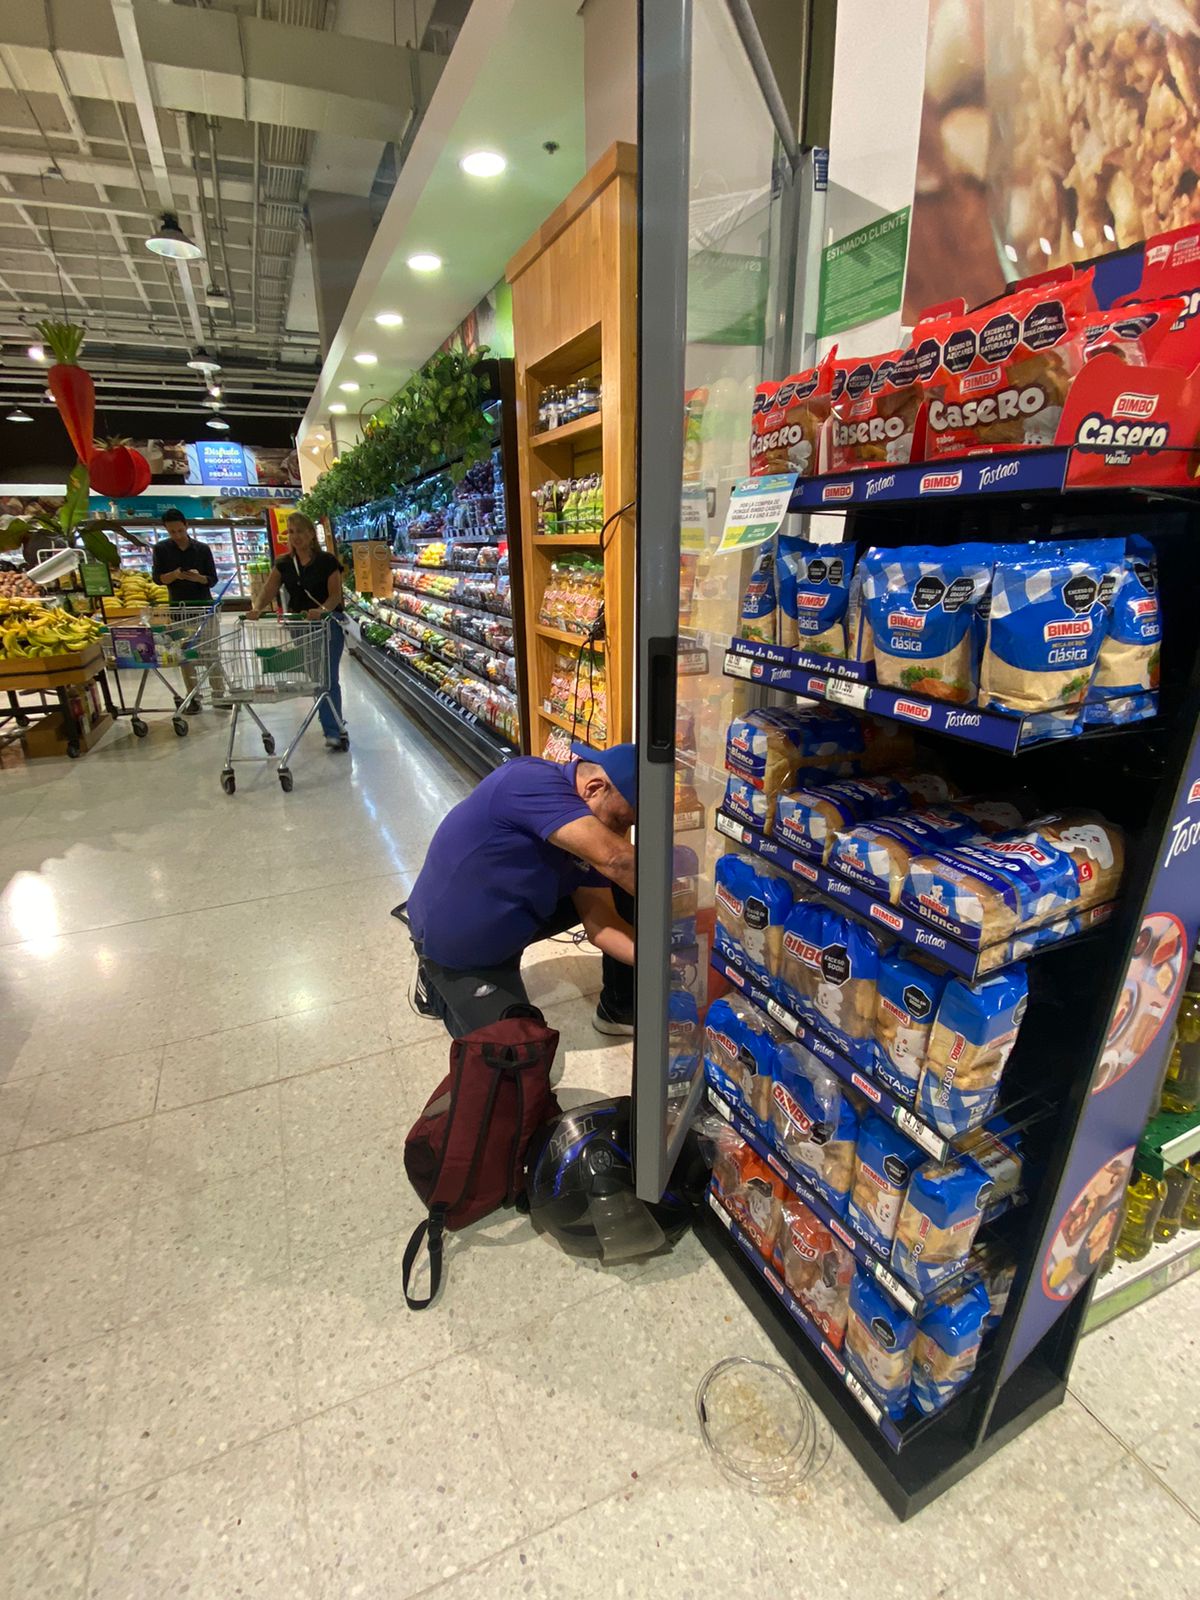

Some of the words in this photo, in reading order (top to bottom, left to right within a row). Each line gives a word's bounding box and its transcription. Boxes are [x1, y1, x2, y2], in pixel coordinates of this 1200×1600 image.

[827, 233, 866, 261] ESTIMADO
[869, 213, 907, 240] CLIENTE
[963, 372, 999, 389] BIMBO
[1117, 398, 1155, 414] BIMBO
[1078, 417, 1168, 448] Casero
[825, 485, 852, 498] BIMBO
[865, 474, 896, 500] Tostaos
[923, 475, 959, 489] BIMBO
[978, 461, 1021, 491] Tostaos
[798, 595, 827, 607] BIMBO
[890, 615, 924, 629] BIMBO
[1047, 622, 1091, 637] BIMBO
[891, 636, 922, 652] Clásica
[1047, 648, 1088, 664] Clásica
[810, 681, 826, 692] BIM
[896, 702, 929, 718] BIMBO
[945, 711, 982, 729] Tostaos
[730, 748, 754, 766] Blanco
[730, 801, 754, 822] Blanco
[784, 818, 804, 833] BIMBO
[782, 827, 812, 850] Blanco
[841, 854, 865, 870] BIMBO
[953, 846, 1021, 873] Blanco
[983, 842, 1046, 863] BIMBO
[840, 864, 876, 886] Blanco
[716, 884, 742, 915] BIMBO
[759, 840, 779, 855] Tostaos
[795, 863, 817, 879] BIMBO
[827, 878, 852, 896] Tostaos
[872, 907, 902, 929] BIMBO
[915, 928, 947, 950] Tostaos
[920, 895, 947, 915] BIMBO
[919, 905, 961, 936] Blanco
[883, 1001, 910, 1024] BIMBO
[951, 1034, 966, 1062] BIMBO
[813, 1039, 835, 1060] Tostaos
[853, 1077, 879, 1101] BIMBO
[773, 1086, 811, 1130] BIMBO
[863, 1165, 889, 1190] BIMBO
[792, 1234, 816, 1258] MBO
[831, 1221, 854, 1249] BIMBO
[822, 1344, 844, 1373] BIMBO
